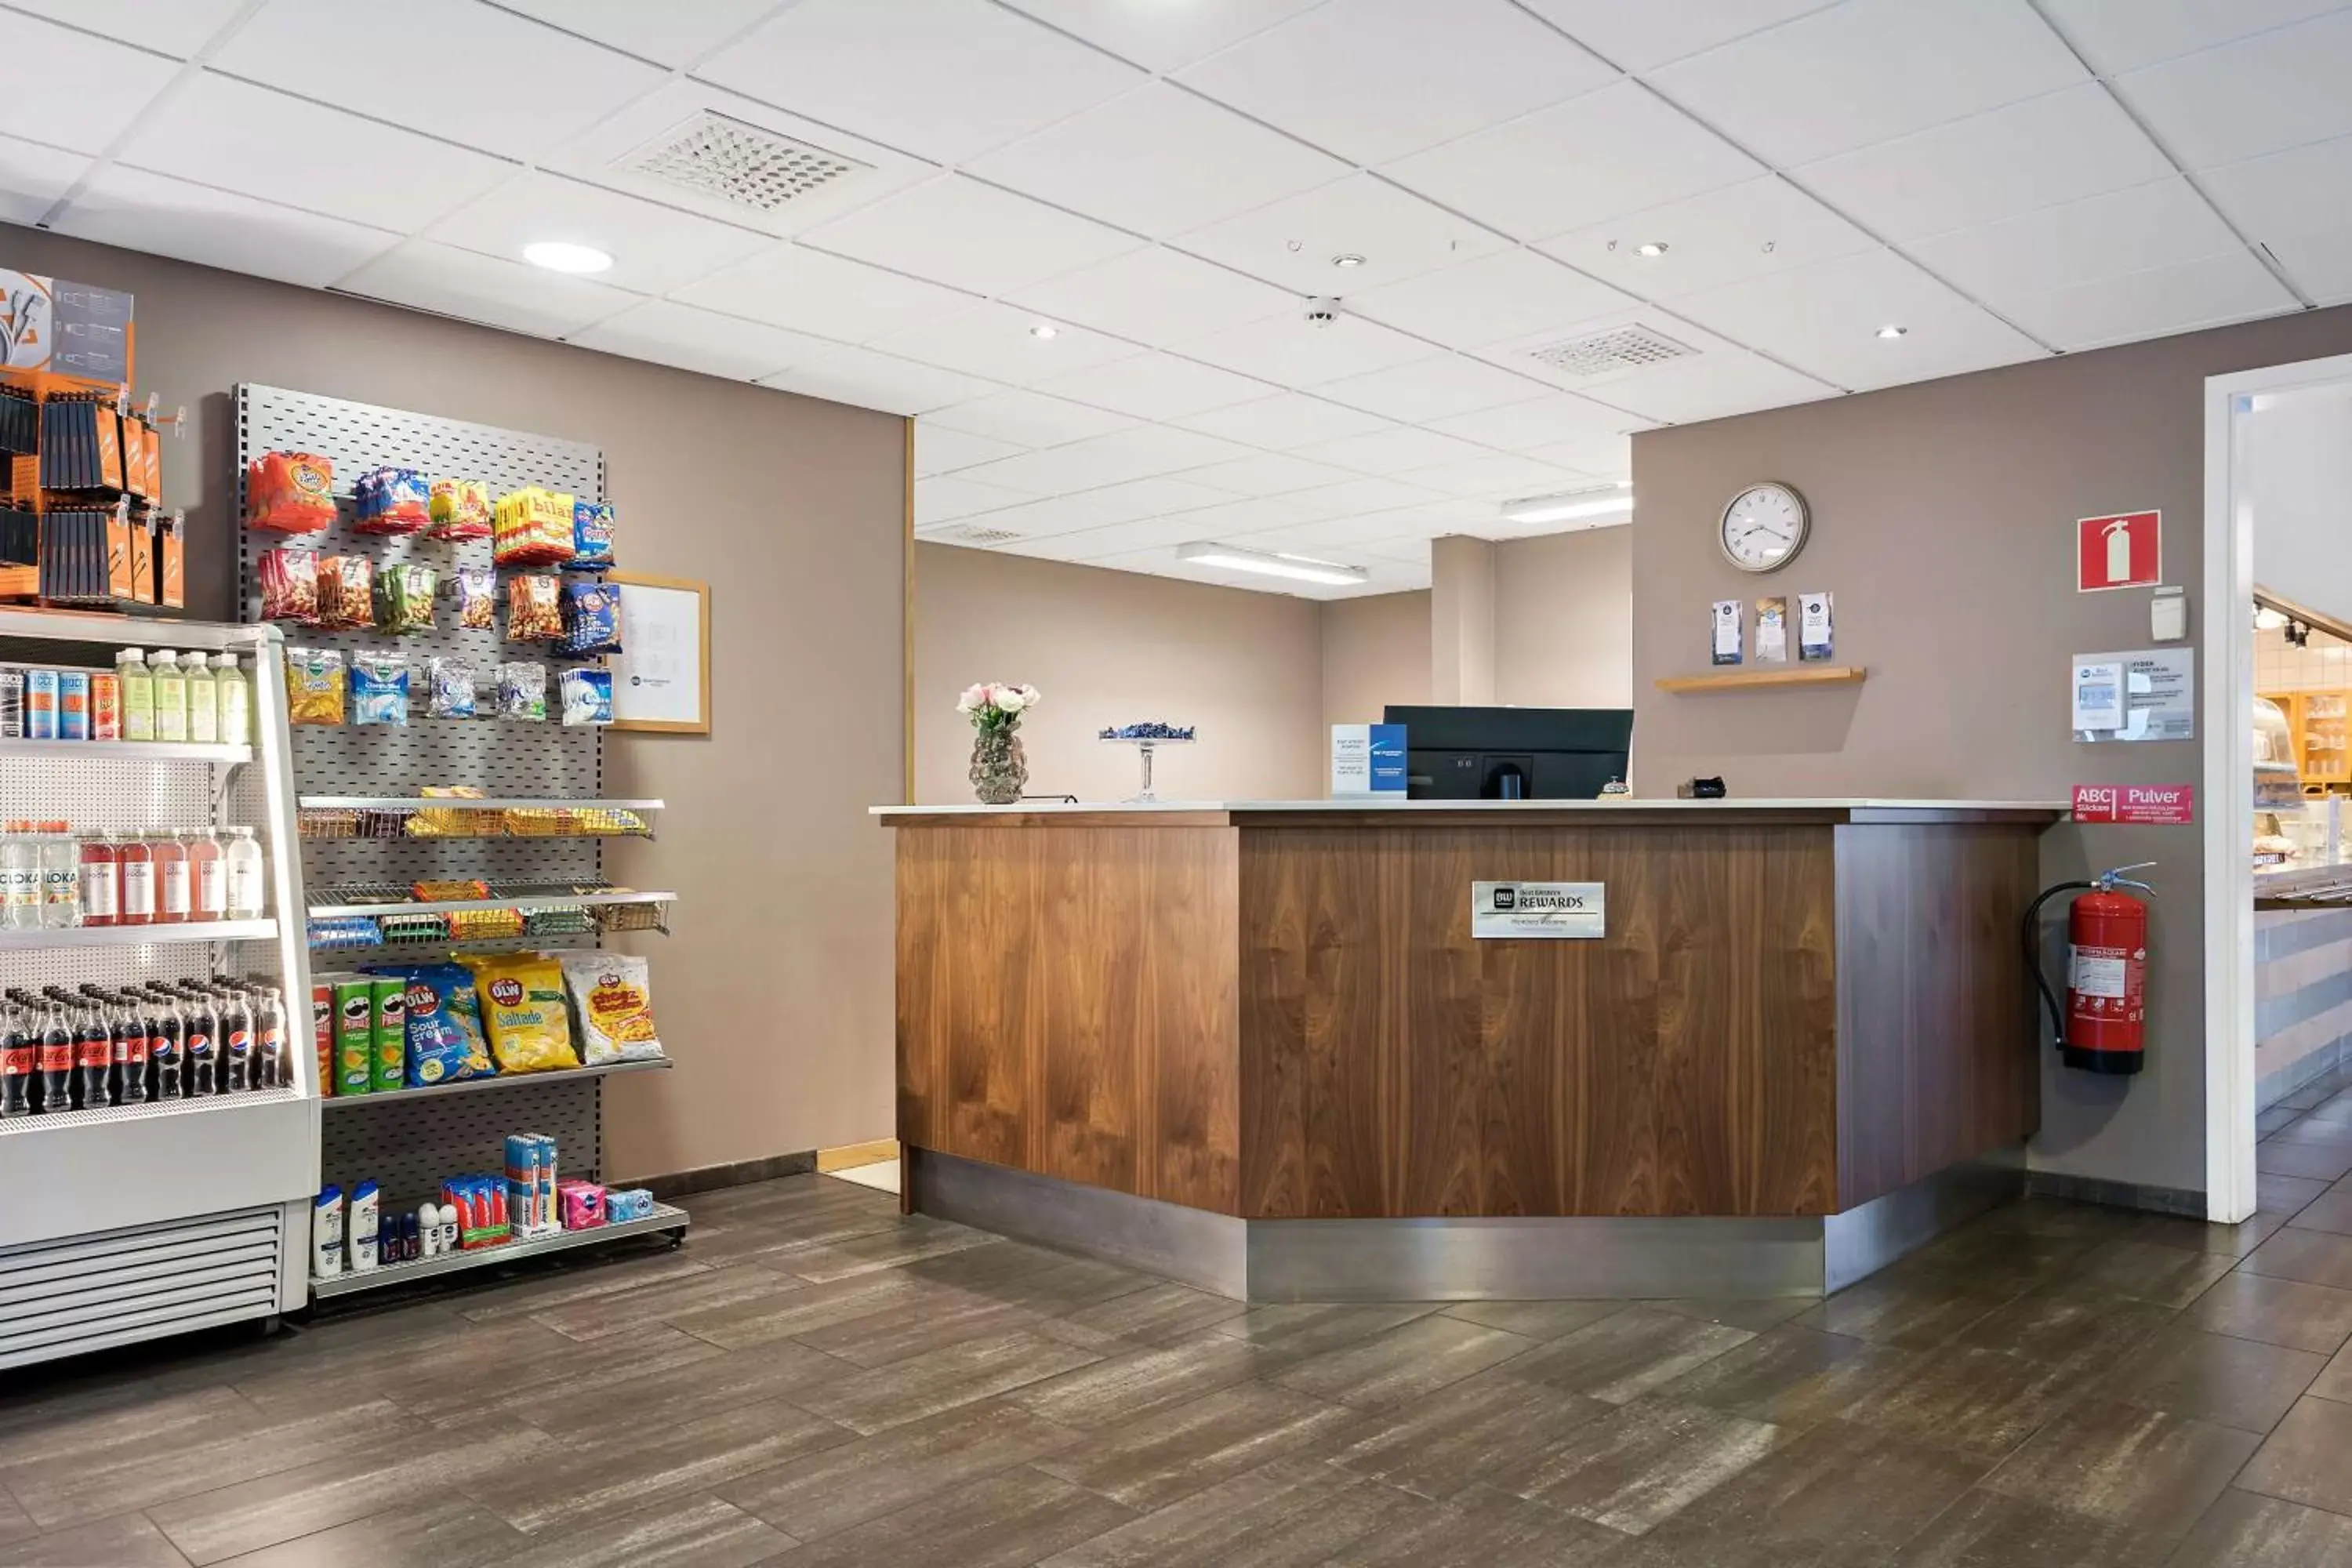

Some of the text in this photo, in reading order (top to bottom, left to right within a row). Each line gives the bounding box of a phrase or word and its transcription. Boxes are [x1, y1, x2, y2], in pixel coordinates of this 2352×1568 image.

[2077, 788, 2180, 804] ABC Pulver
[46, 872, 76, 884] LOKA
[1519, 896, 1584, 909] REWARDS
[492, 984, 519, 998] OLW
[405, 992, 435, 1007] OLW
[408, 1020, 440, 1034] Sour
[412, 1025, 452, 1042] cream
